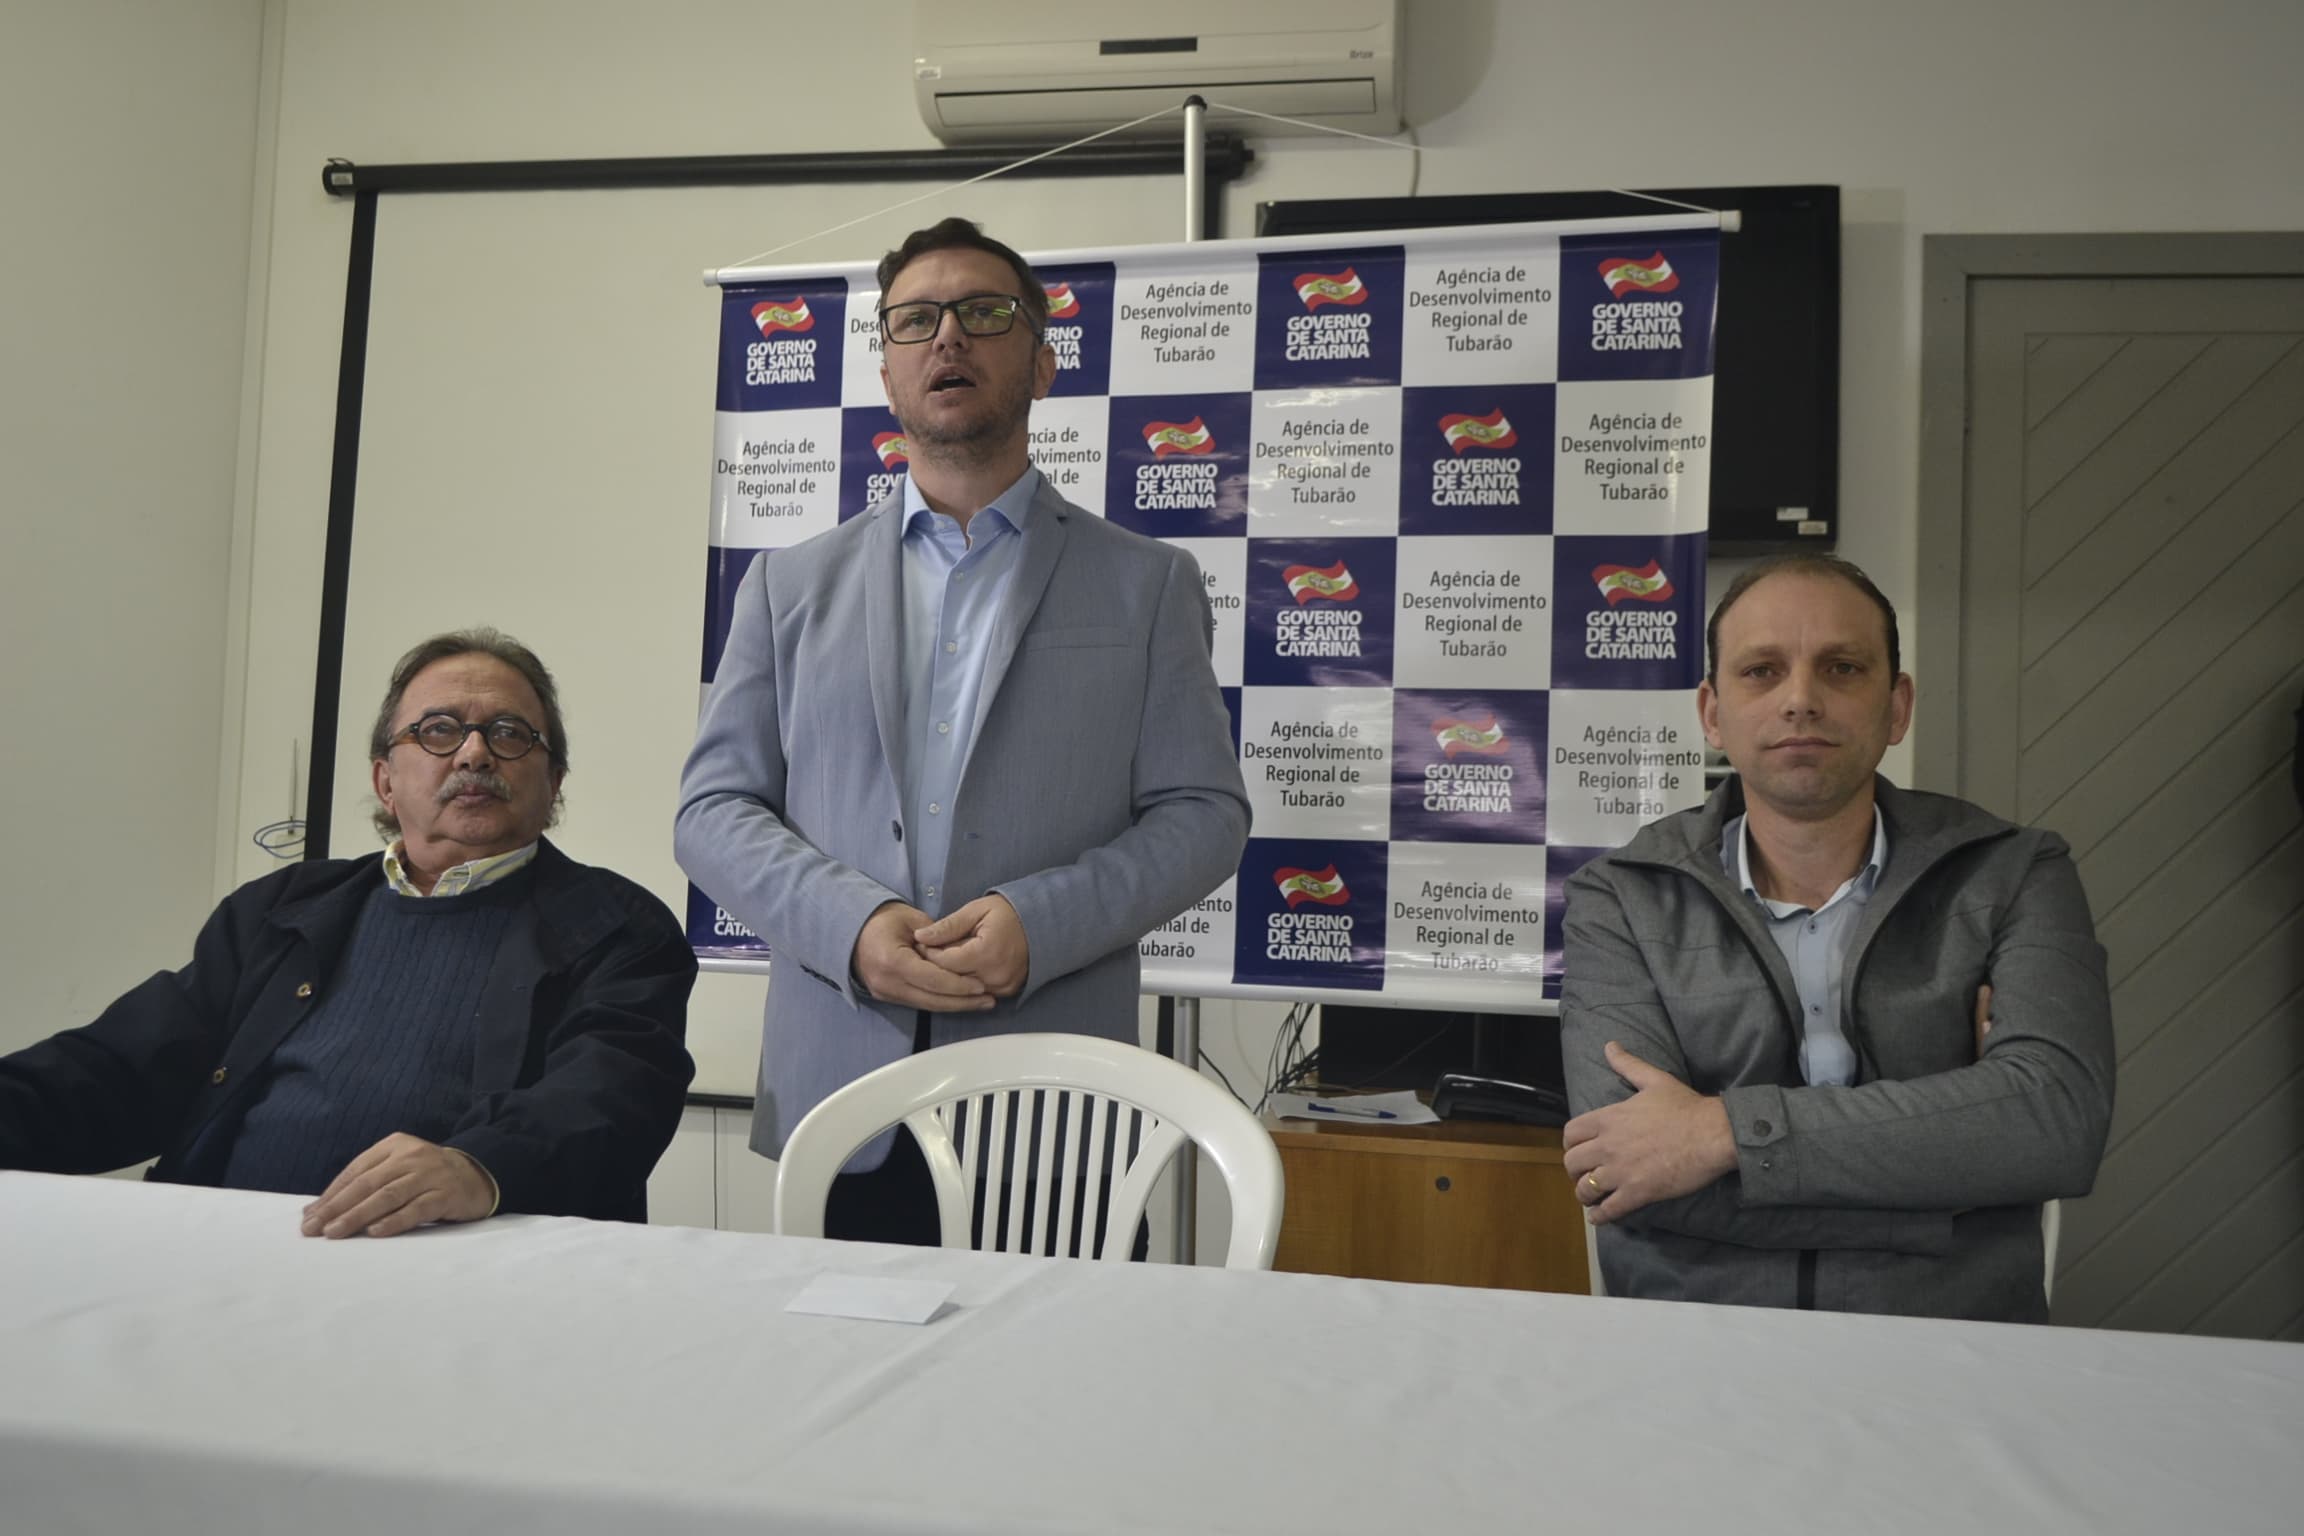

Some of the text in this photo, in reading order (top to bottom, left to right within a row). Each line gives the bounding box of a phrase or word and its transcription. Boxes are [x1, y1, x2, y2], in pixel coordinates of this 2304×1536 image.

[1436, 266, 1525, 288] Agência de
[1146, 281, 1229, 302] Agência de
[1410, 288, 1551, 307] Desenvolvimento
[1121, 301, 1252, 320] Desenvolvimento
[1592, 301, 1683, 319] GOVERNO
[1287, 313, 1371, 331] GOVERNO
[1432, 309, 1527, 331] Regional de
[1592, 317, 1682, 335] DE SANTA
[1141, 322, 1229, 343] Regional de
[1287, 328, 1370, 346] DE SANTA
[747, 339, 817, 357] GOVERNO
[1049, 340, 1080, 355] NTA
[1446, 335, 1512, 351] Tubarão
[1591, 333, 1682, 351] CATARINA
[1154, 346, 1215, 362] Tubarão
[1285, 342, 1370, 361] CATARINA
[747, 353, 814, 371] DE SANTA
[746, 367, 815, 386] CATARINA
[1282, 419, 1369, 440] Agência de
[1589, 412, 1682, 434] Agência de
[1028, 427, 1079, 443] ncia de
[1562, 435, 1706, 453] Desenvolvimento
[743, 438, 815, 459] Agência de
[1029, 448, 1101, 464] olvimento
[1256, 440, 1394, 462] Desenvolvimento
[718, 459, 835, 475] Desenvolvimento
[1136, 463, 1218, 480] GOVERNO
[1278, 459, 1370, 483] Regional de
[1433, 457, 1520, 475] GOVERNO
[1585, 458, 1684, 479] Regional de
[1061, 468, 1079, 484] de
[1433, 473, 1519, 490] DE SANTA
[738, 478, 815, 499] Regional de
[1136, 477, 1216, 495] DE SANTA
[1291, 486, 1355, 503] Tubarão
[1600, 483, 1668, 500] Tubarão
[1135, 492, 1216, 510] CATARINA
[1432, 489, 1520, 506] CATARINA
[750, 502, 803, 517] Tubarão
[1430, 570, 1520, 591] Agência de
[1403, 592, 1546, 609] Desenvolvimento
[1276, 610, 1362, 626] GOVERNO
[1425, 615, 1522, 635] Regional de
[1586, 611, 1677, 627] GOVERNO
[1276, 625, 1361, 641] DE SANTA
[1586, 627, 1676, 643] DE SANTA
[1275, 641, 1361, 657] CATARINA
[1440, 640, 1506, 656] Tubarão
[1585, 642, 1676, 659] CATARINA
[1271, 721, 1358, 741] Agência de
[1584, 726, 1677, 747] Agência de
[1245, 742, 1383, 760] Desenvolvimento
[1556, 747, 1701, 766] Desenvolvimento
[1266, 765, 1360, 785] Regional de
[1424, 764, 1513, 781] GOVERNO
[1579, 771, 1679, 792] Regional de
[1424, 780, 1511, 796] DE SANTA
[1280, 790, 1344, 807] Tubarão
[1423, 795, 1512, 812] CATARINA
[1594, 797, 1664, 815] Tubarão
[1421, 881, 1512, 902] Agência de
[1267, 913, 1353, 930] GOVERNO
[1395, 902, 1538, 924] Desenvolvimento
[1191, 917, 1209, 933] de
[1268, 929, 1352, 946] DE SANTA
[1417, 926, 1514, 948] Regional de
[1141, 939, 1194, 958] ubarão
[1266, 944, 1352, 962] CATARINA
